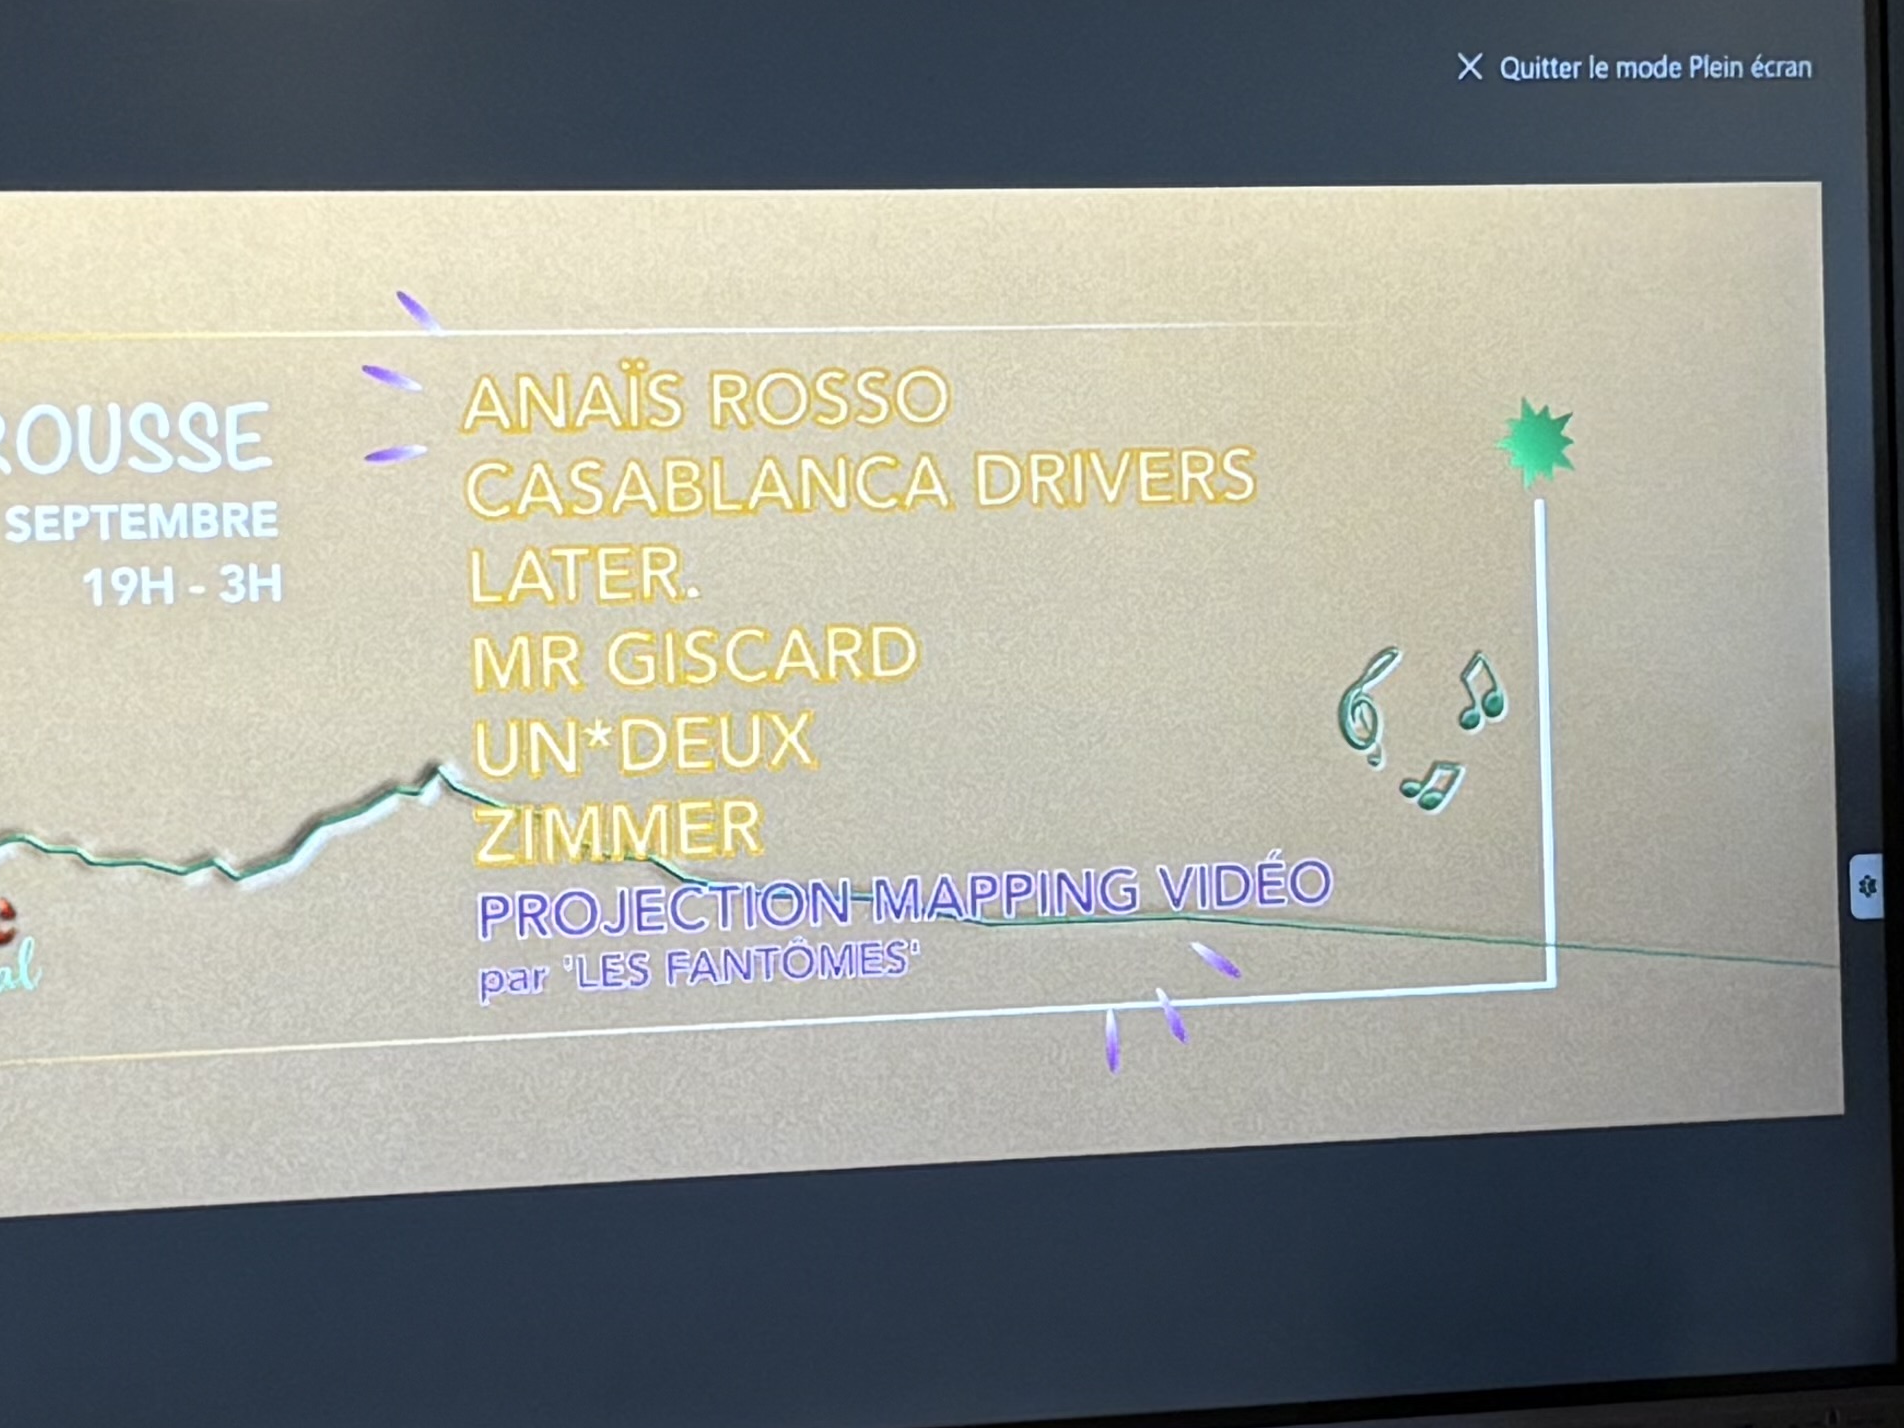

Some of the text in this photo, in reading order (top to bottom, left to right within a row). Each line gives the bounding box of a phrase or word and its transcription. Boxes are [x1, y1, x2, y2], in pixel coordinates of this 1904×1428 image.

[1500, 54, 1812, 82] Quitter le mode Plein écran
[459, 357, 953, 433] ANAÏS ROSSO
[463, 443, 1258, 519] CASABLANCA DRIVERS
[5, 502, 279, 543] SEPTEMBRE
[82, 566, 175, 607] 19H
[219, 563, 283, 603] 3H
[468, 543, 702, 607] LATER.
[470, 624, 919, 694] MR GISCARD
[472, 798, 766, 869] ZIMMER
[476, 849, 1336, 943] PROJECTION MAPPING VIDÉO
[477, 962, 551, 1005] par
